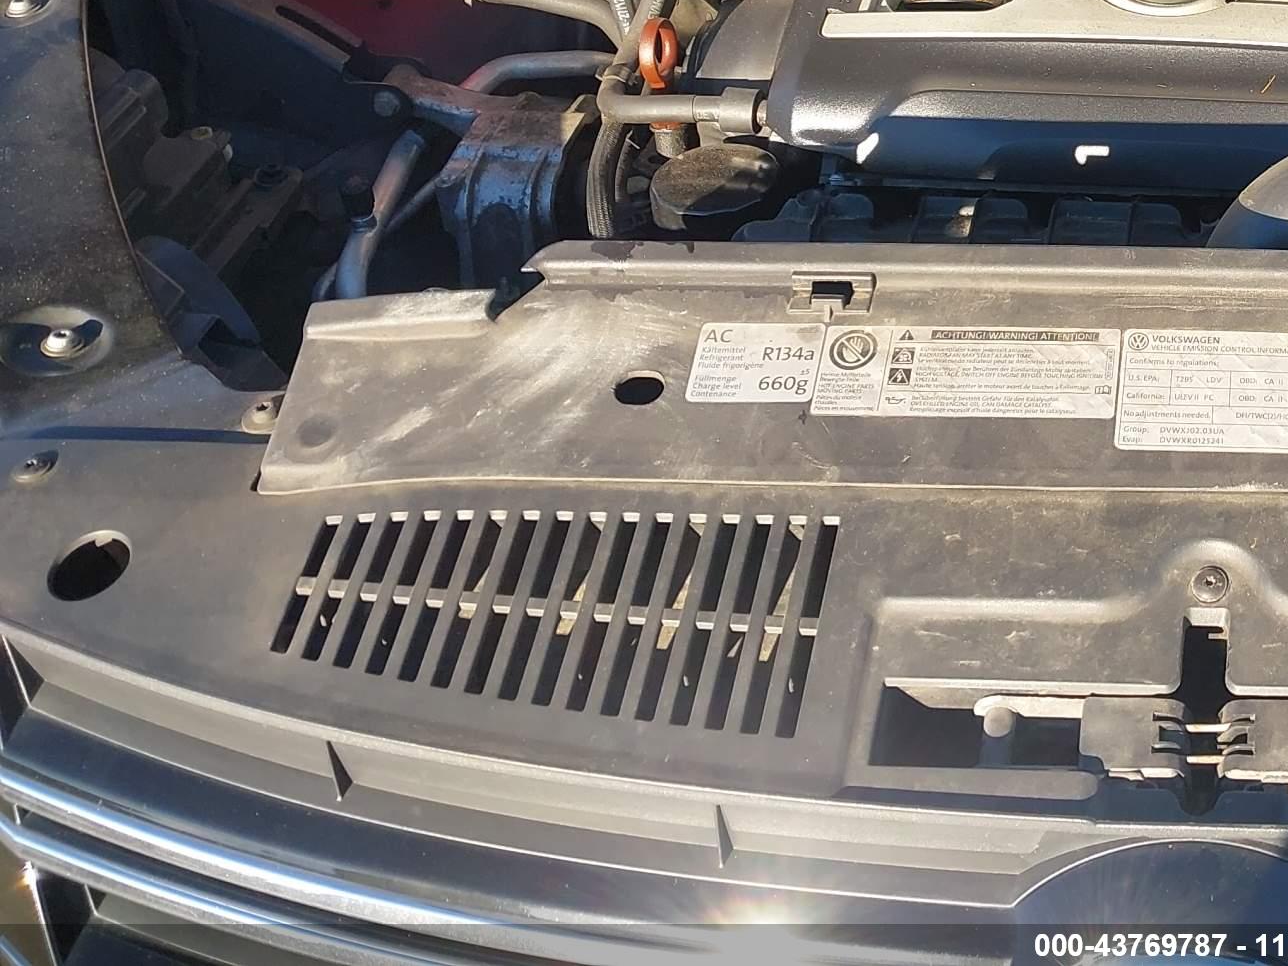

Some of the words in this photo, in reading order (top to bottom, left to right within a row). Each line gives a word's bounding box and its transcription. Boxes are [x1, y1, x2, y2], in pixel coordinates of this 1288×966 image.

[704, 330, 733, 343] AC
[936, 332, 986, 340] ACHTUNG!
[988, 332, 1039, 341] WARNING!
[1040, 332, 1097, 341] ATTENTION!
[1152, 335, 1221, 344] VOLKSWAGEN
[702, 346, 746, 354] Kältemittel
[762, 347, 815, 361] R134a
[1220, 346, 1256, 354] CONTROL
[699, 354, 744, 362] Refrigerant
[1130, 358, 1165, 366] Conforms
[1176, 360, 1219, 368] regulations:
[695, 375, 737, 383] Füllmenge
[692, 383, 721, 391] Charge
[758, 376, 809, 395] 660g
[1135, 410, 1181, 419] adjustments
[1124, 426, 1149, 434] Group:
